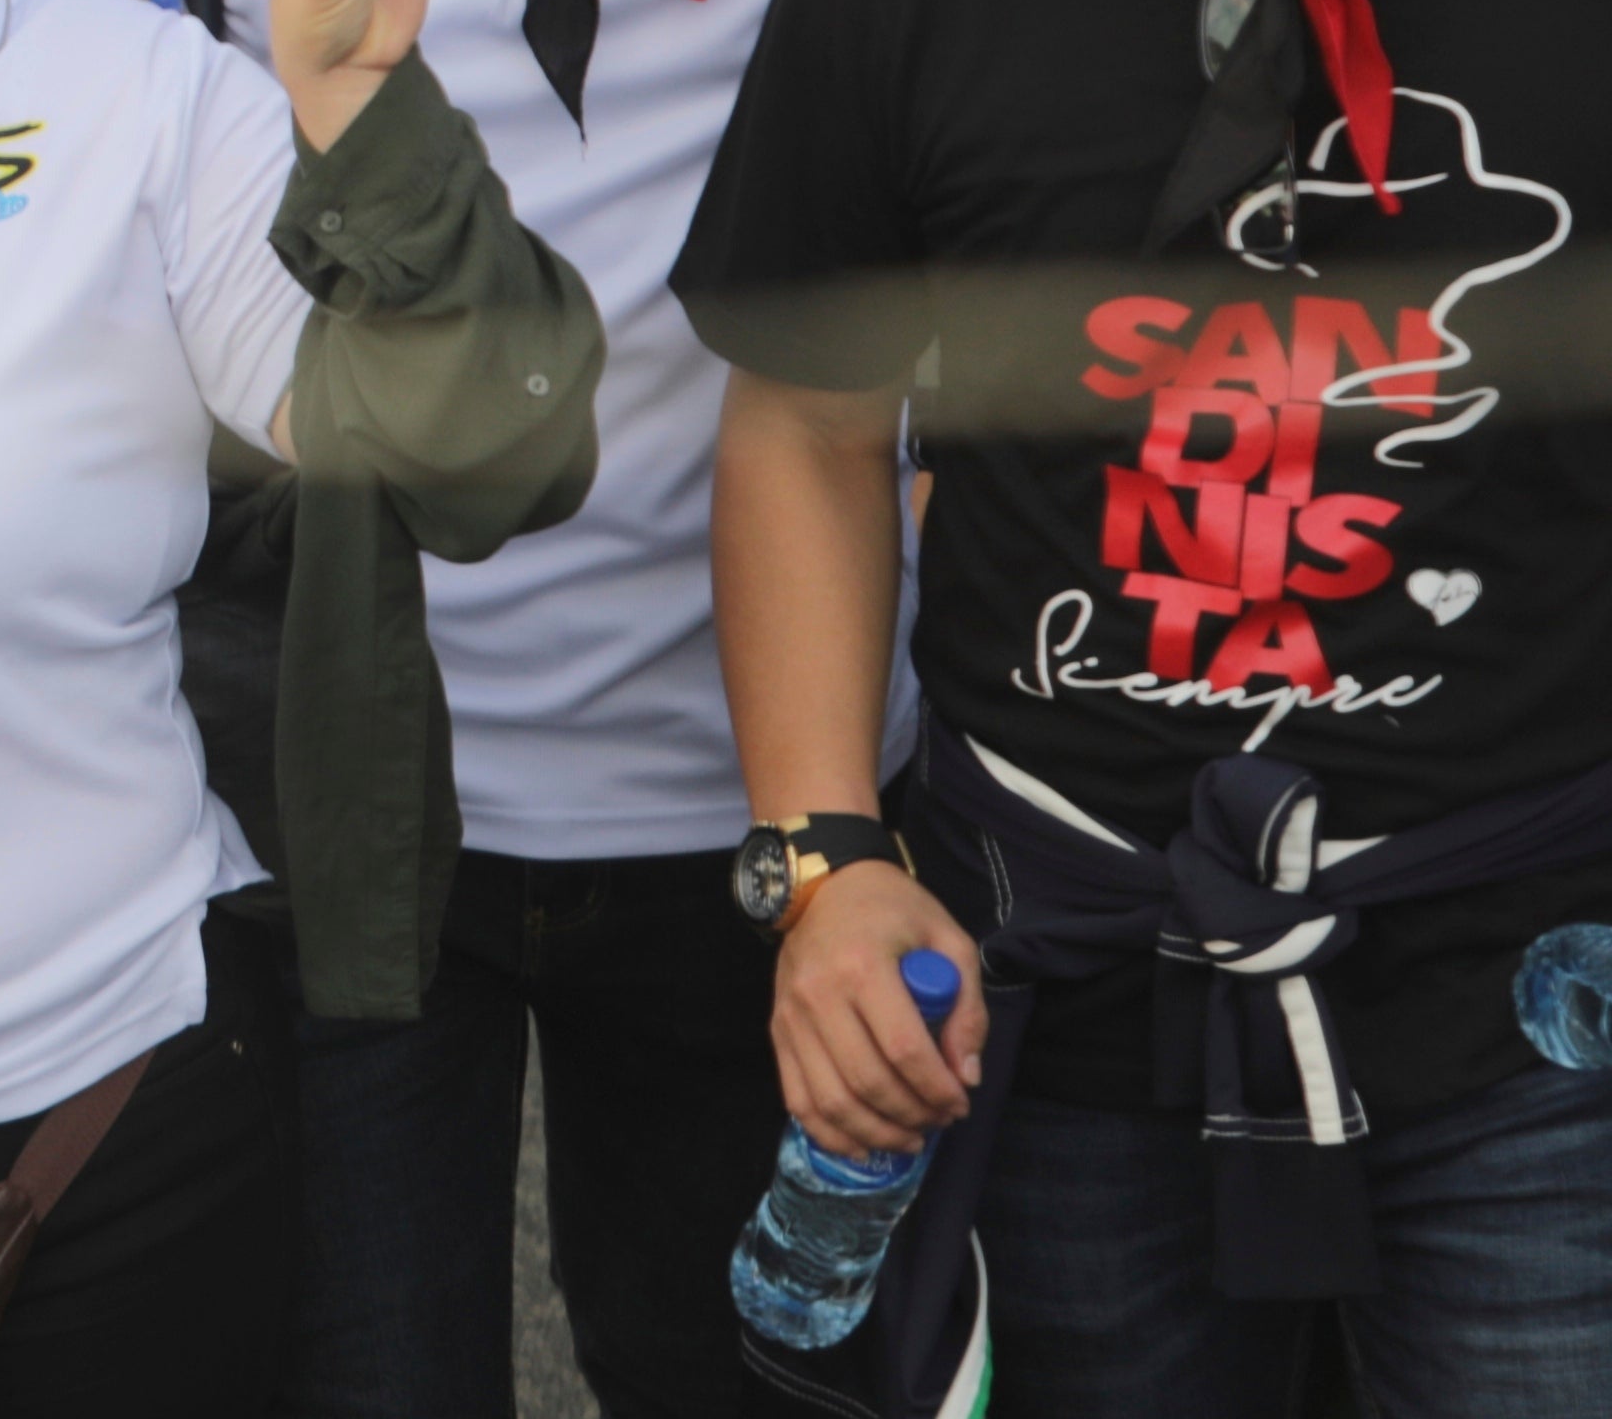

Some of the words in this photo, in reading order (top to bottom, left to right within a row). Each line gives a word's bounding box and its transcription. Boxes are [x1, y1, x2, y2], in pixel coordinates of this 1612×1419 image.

[1081, 295, 1442, 419] SAN
[1140, 386, 1323, 509] DI
[1099, 464, 1403, 601] NIS
[1011, 588, 1444, 753] Siempre
[1120, 571, 1337, 698] TA
